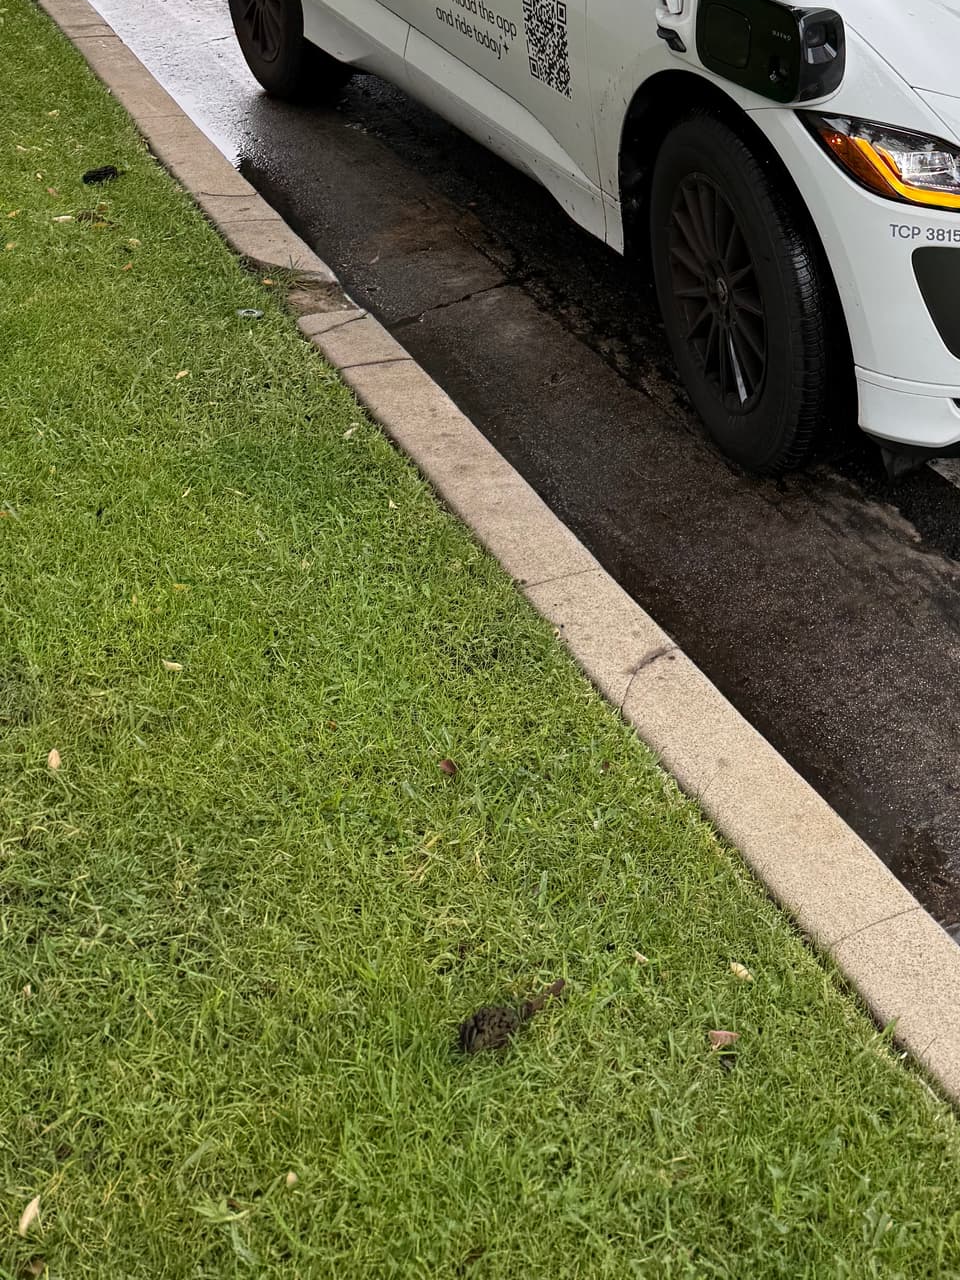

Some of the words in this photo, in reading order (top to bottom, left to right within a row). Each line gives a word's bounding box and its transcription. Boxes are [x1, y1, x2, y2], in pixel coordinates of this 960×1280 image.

[436, 7, 454, 27] and
[455, 14, 473, 39] ride
[473, 25, 501, 60] today
[478, 0, 495, 25] the
[496, 15, 517, 40] app
[889, 223, 921, 239] TCP
